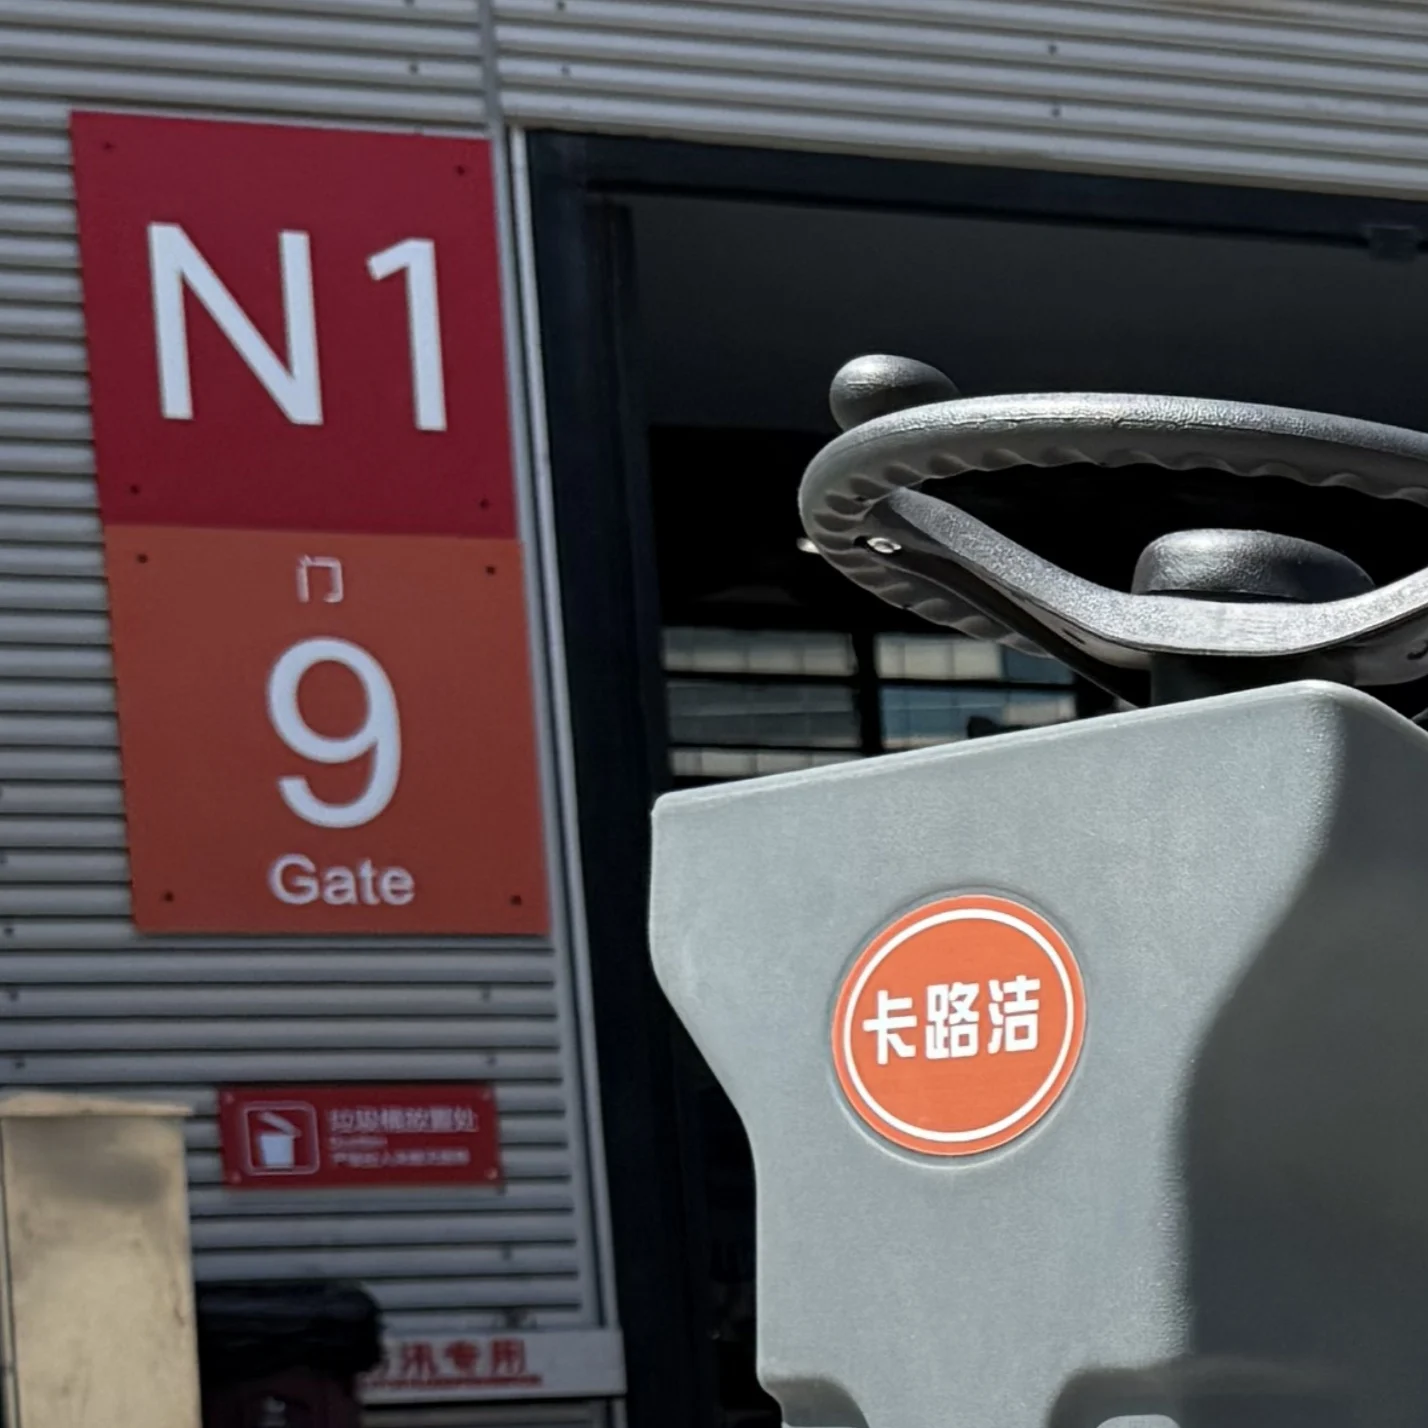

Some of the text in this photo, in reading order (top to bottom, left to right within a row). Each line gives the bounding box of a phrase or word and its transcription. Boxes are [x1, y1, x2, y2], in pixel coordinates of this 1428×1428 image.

[147, 221, 448, 432] N1
[297, 555, 344, 603] 门
[267, 637, 401, 829] 9
[269, 854, 415, 906] Gate
[862, 975, 1041, 1065] 卡路洁
